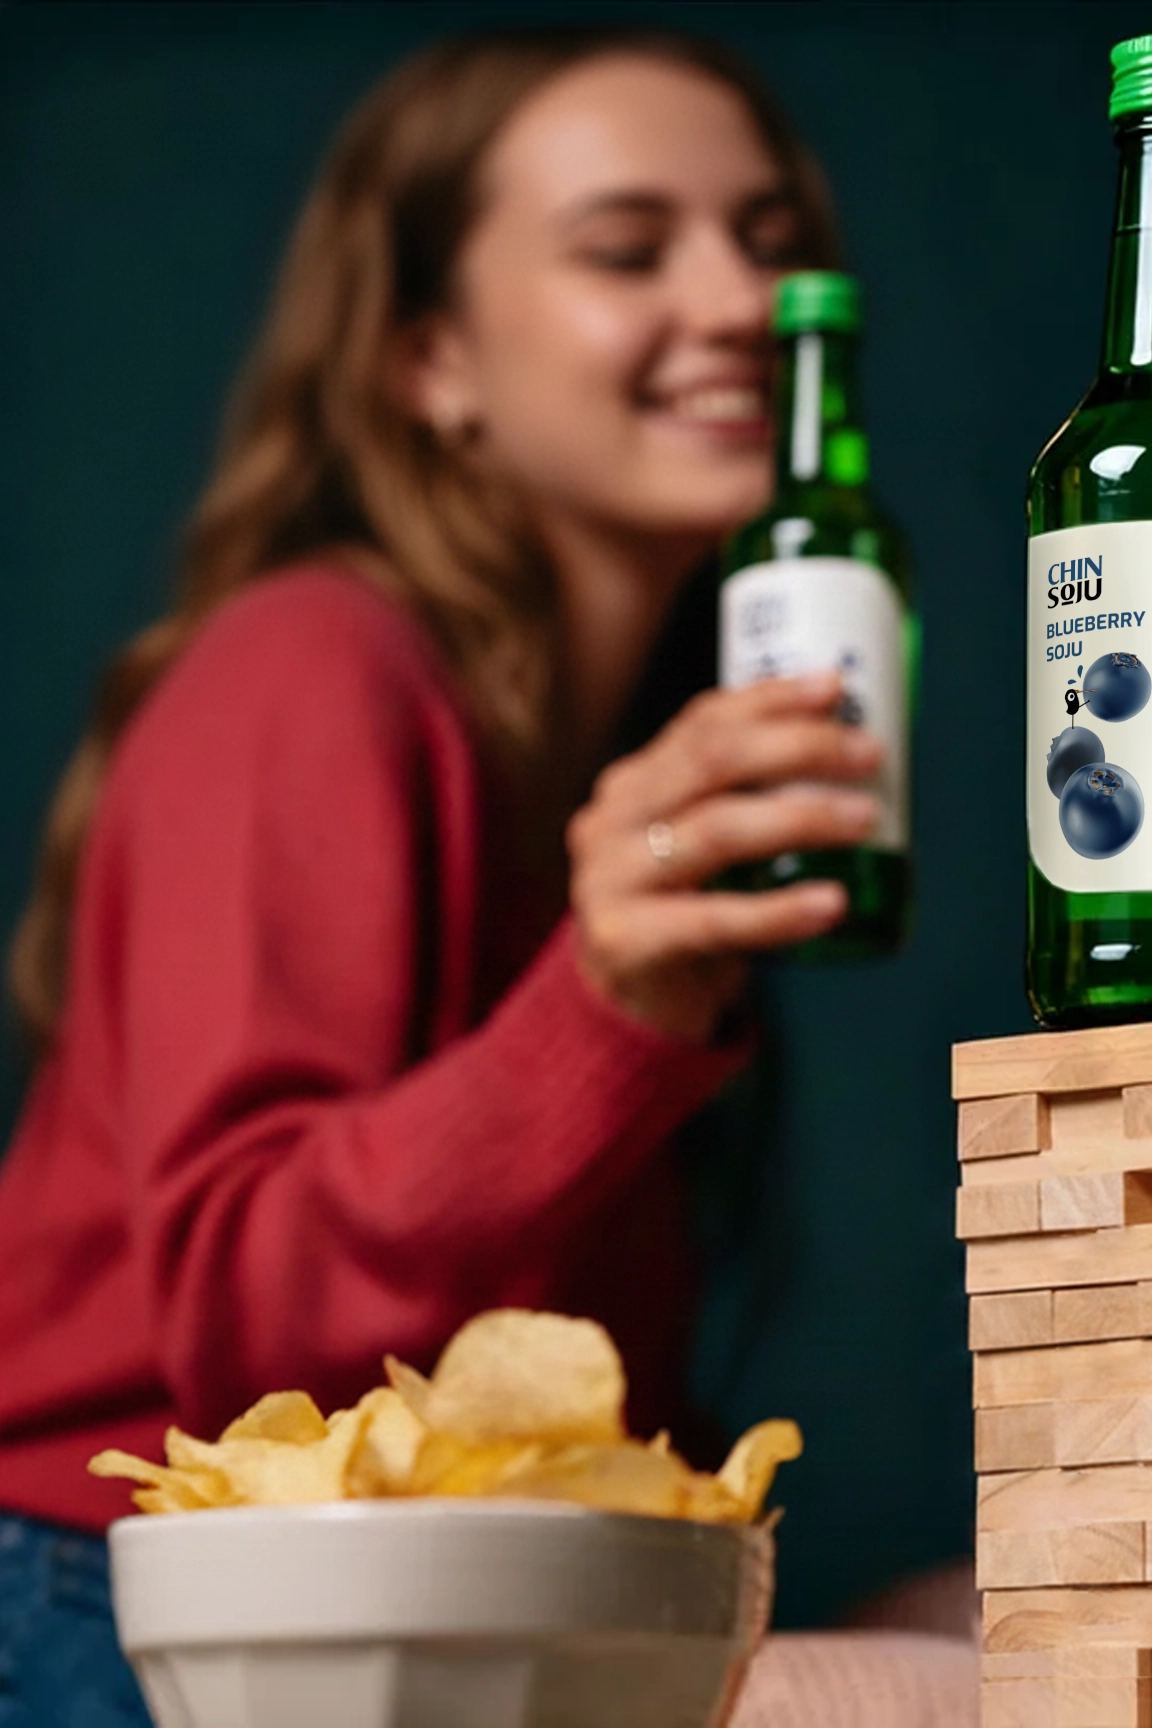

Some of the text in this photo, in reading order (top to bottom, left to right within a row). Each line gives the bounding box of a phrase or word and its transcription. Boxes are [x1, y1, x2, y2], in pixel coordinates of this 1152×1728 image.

[1048, 555, 1102, 585] CHIN
[1046, 611, 1146, 640] BLUEBERRY
[1046, 640, 1083, 662] SOJU
